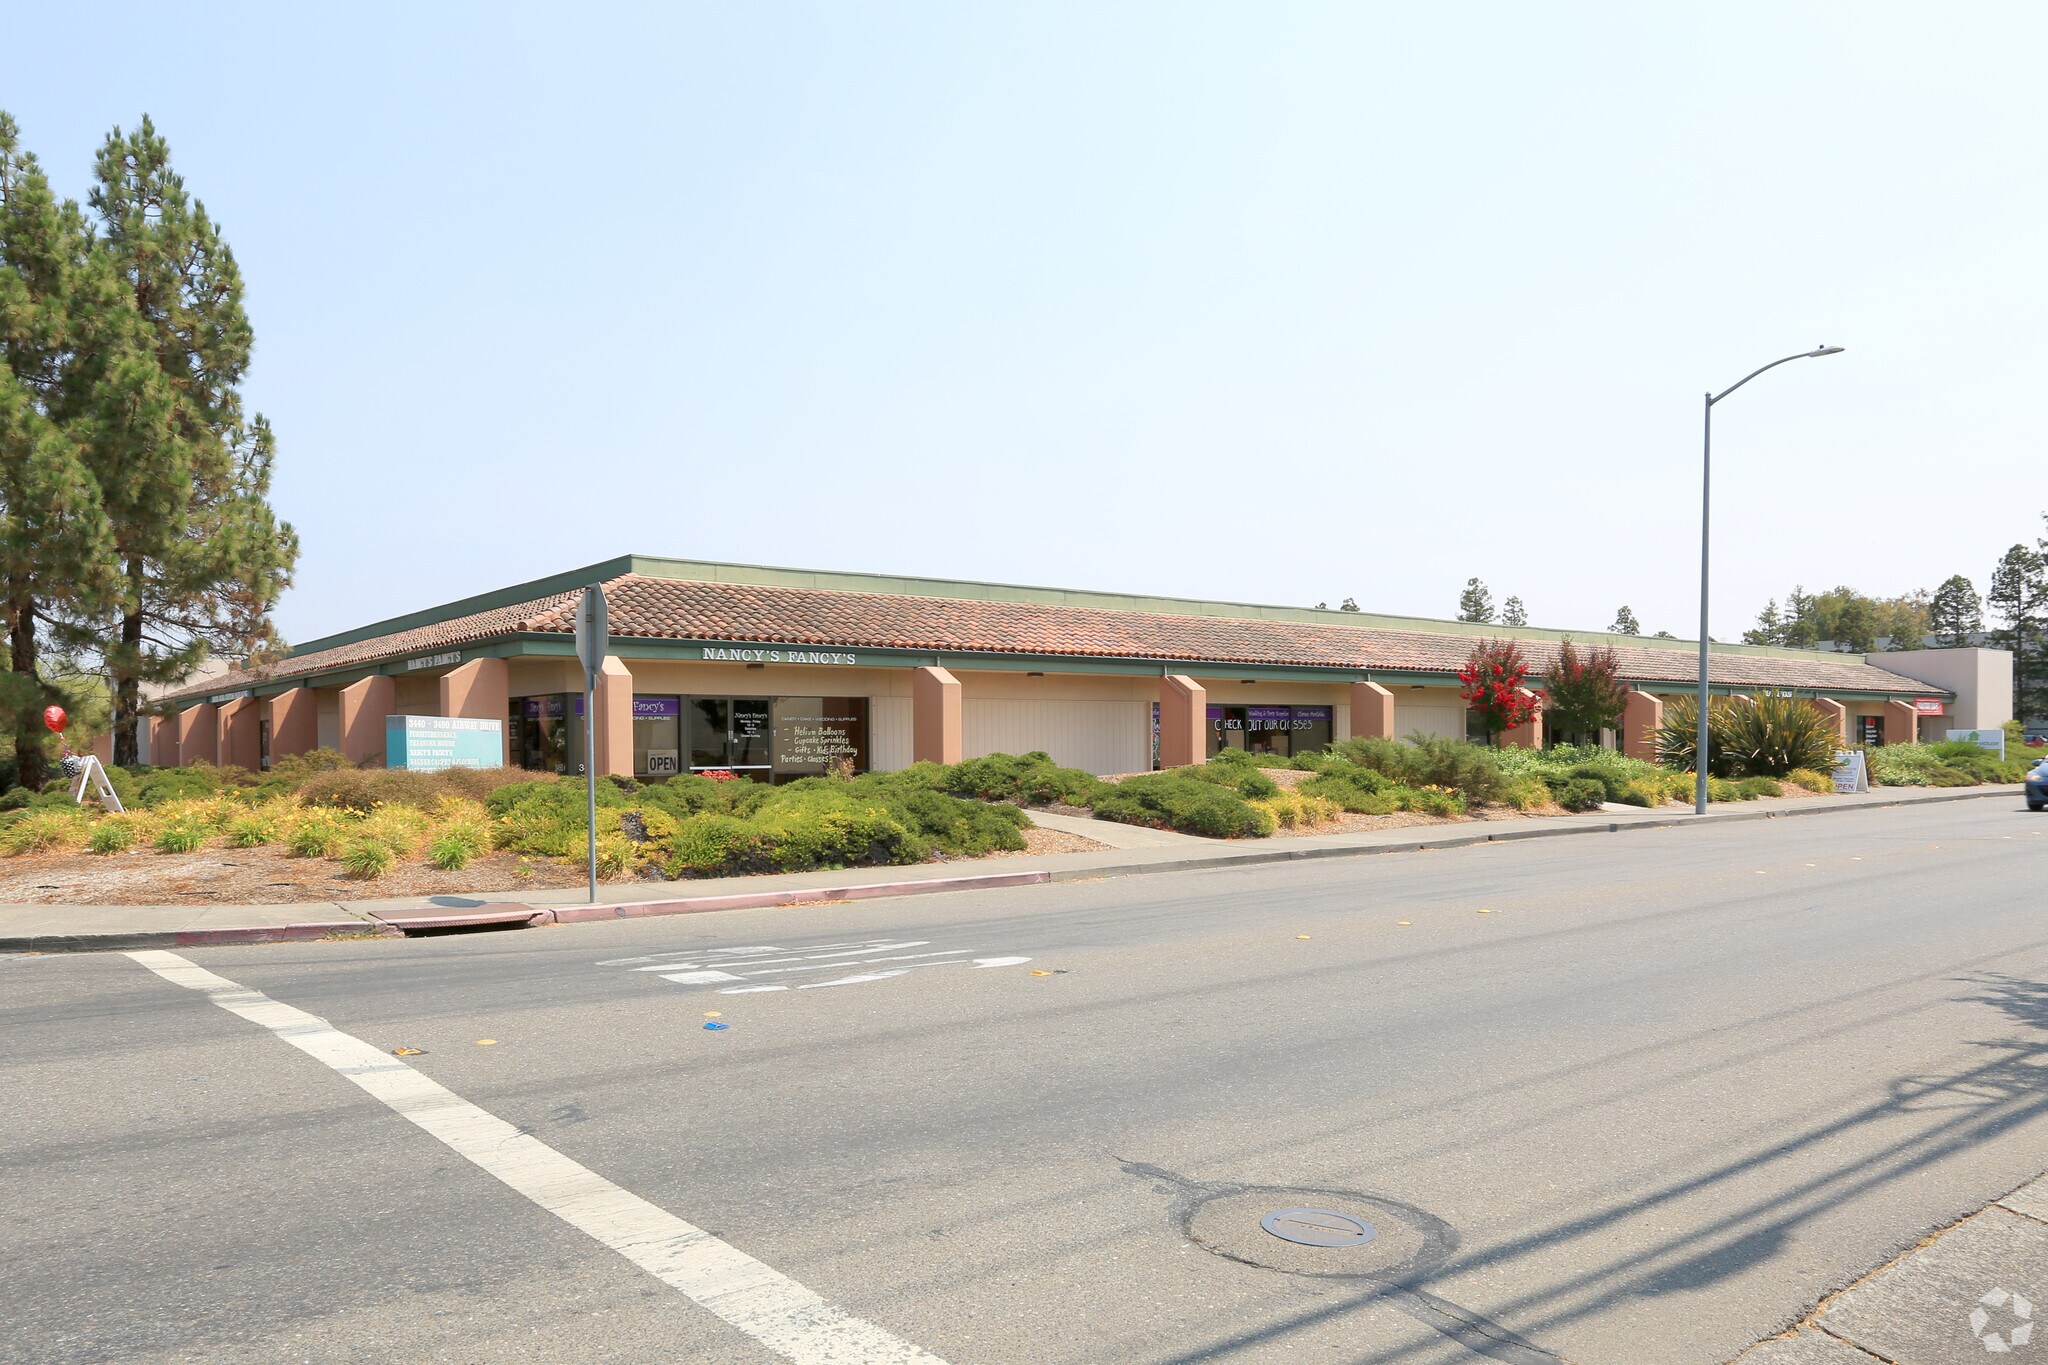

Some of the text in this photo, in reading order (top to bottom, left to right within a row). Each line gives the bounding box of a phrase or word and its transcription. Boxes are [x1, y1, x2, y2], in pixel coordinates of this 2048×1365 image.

[703, 647, 856, 665] NANCY'S FANCY'S
[409, 719, 426, 728] 3440
[479, 721, 500, 731] DRIVE
[649, 756, 677, 771] OPEN
